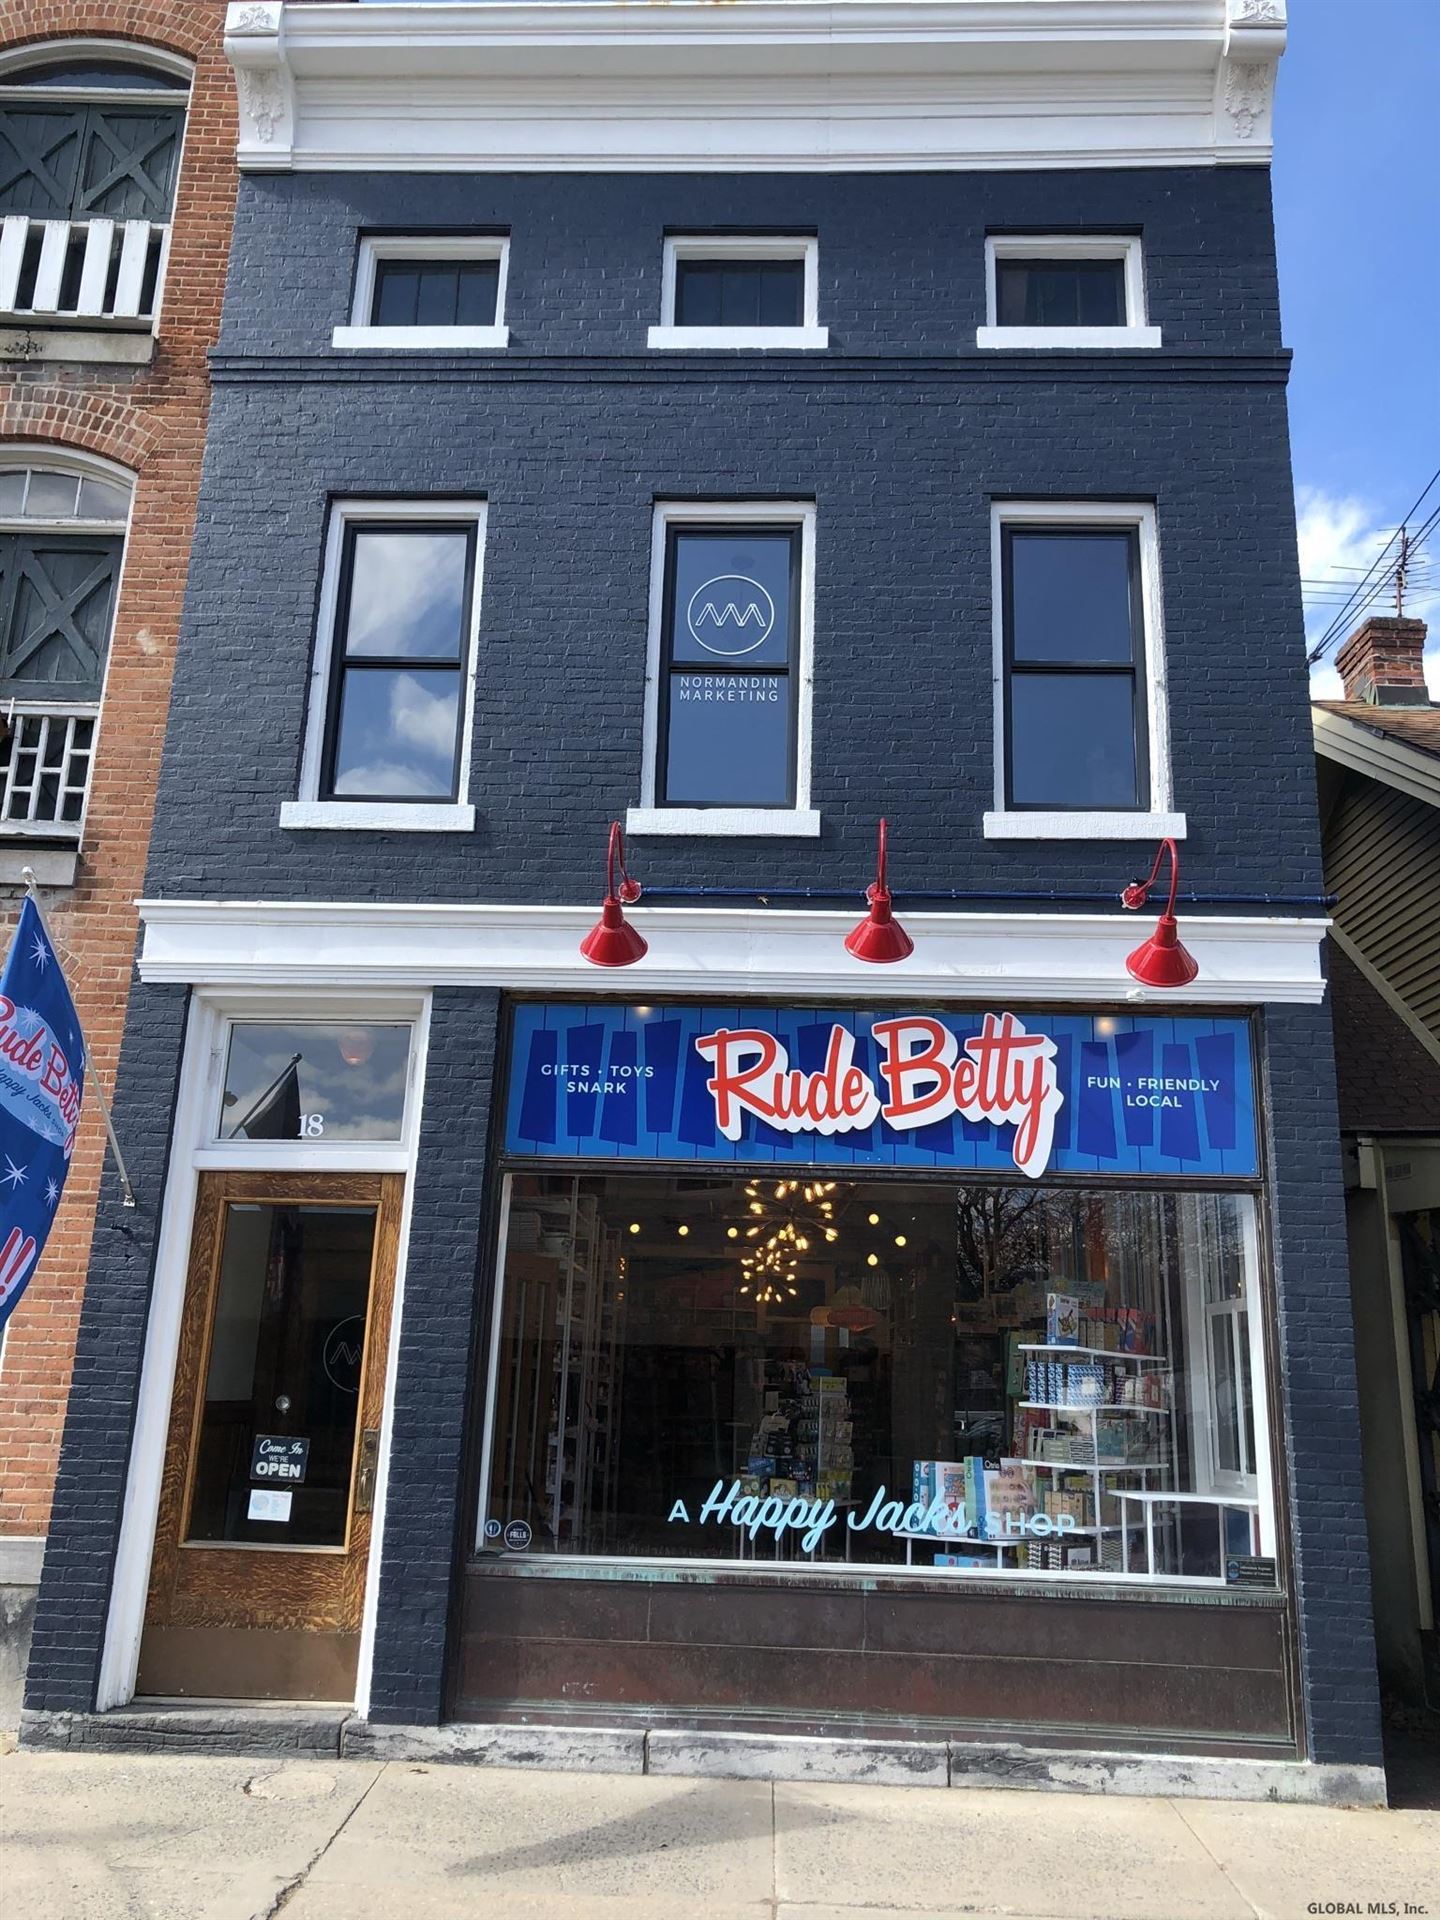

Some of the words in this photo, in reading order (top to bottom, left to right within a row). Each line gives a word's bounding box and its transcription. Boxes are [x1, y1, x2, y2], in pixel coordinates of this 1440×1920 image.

[680, 676, 779, 688] NORMANDIN
[680, 690, 779, 702] MARKETING
[540, 1064, 591, 1077] GIFTS
[610, 1065, 655, 1078] TOYS
[0, 1069, 27, 1097] appy
[566, 1081, 628, 1094] SNARK
[1087, 1076, 1121, 1089] FUN
[1137, 1077, 1221, 1091] FRIENDLY
[695, 1024, 874, 1133] Rude
[872, 1013, 1055, 1169] Betty
[1126, 1095, 1183, 1108] LOCAL
[297, 1113, 324, 1137] 18
[259, 1439, 287, 1454] Come
[288, 1442, 304, 1455] In
[268, 1455, 289, 1463] WE'RE
[255, 1461, 301, 1478] OPEN
[668, 1499, 690, 1523] A
[700, 1479, 837, 1553] Happy
[847, 1484, 973, 1533] Jacks
[985, 1511, 1076, 1537] SHOP
